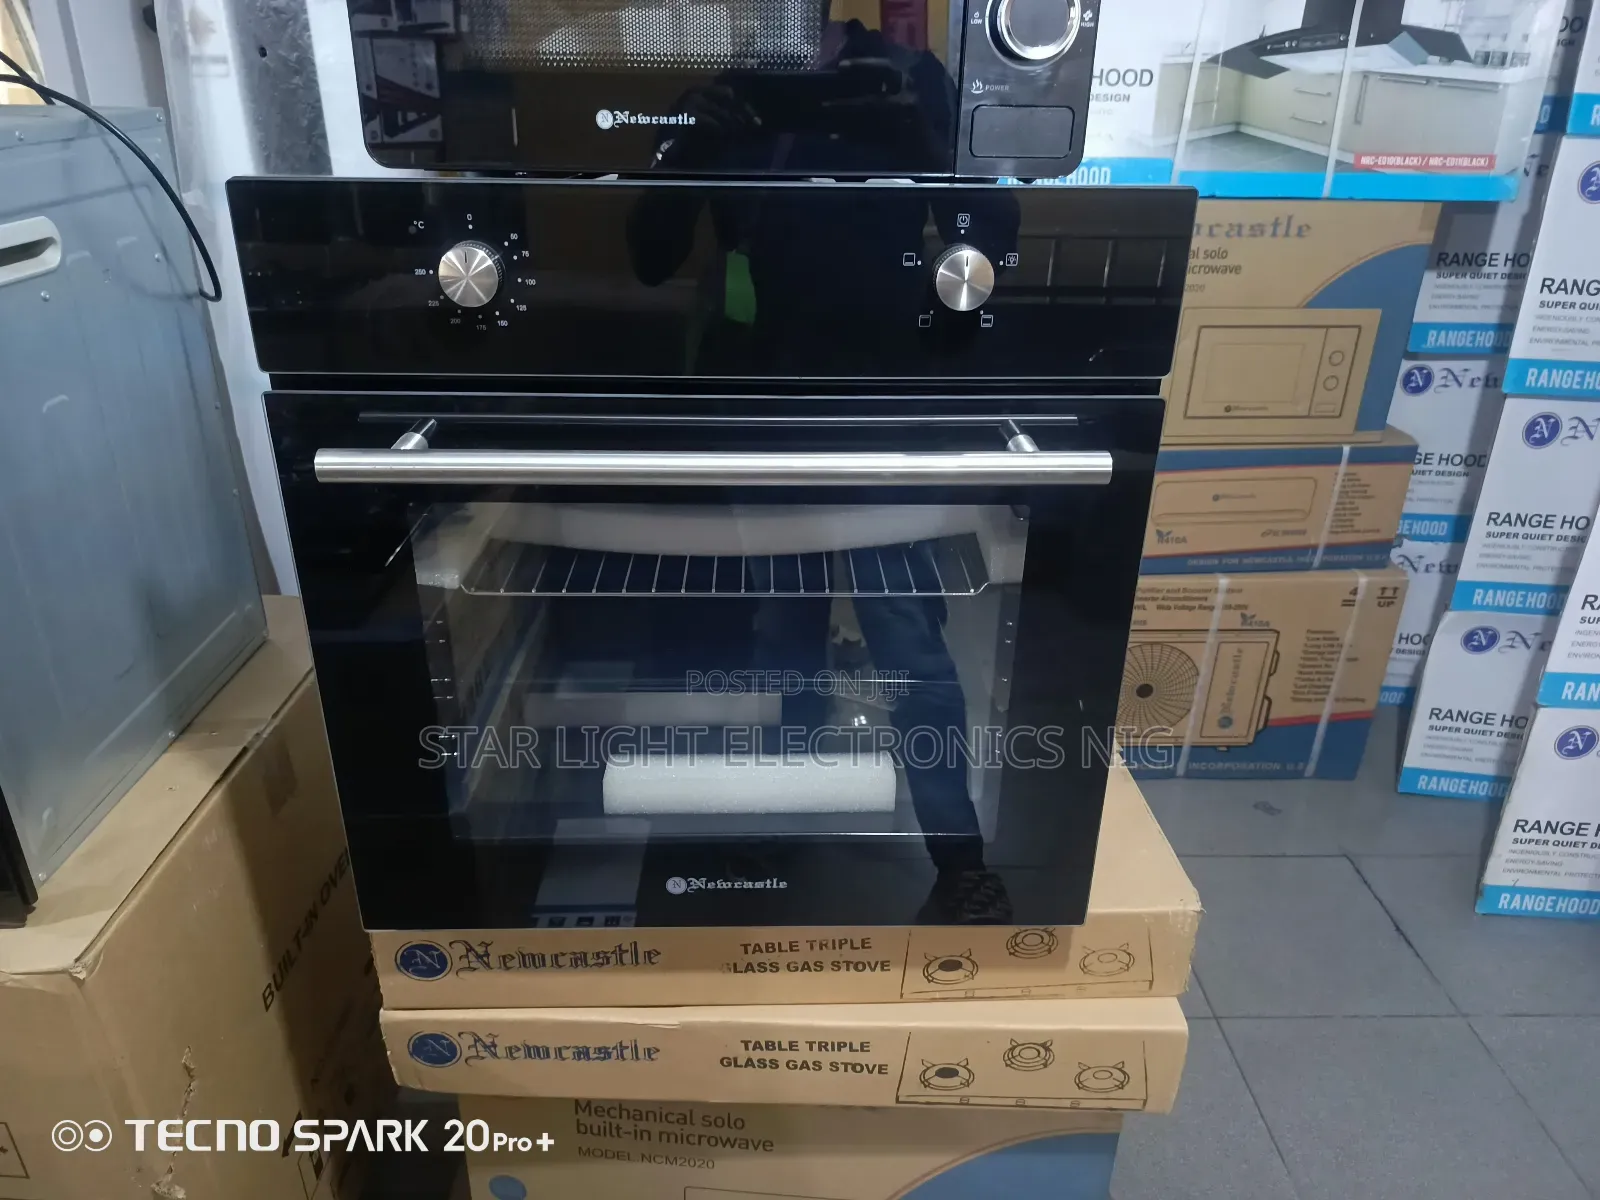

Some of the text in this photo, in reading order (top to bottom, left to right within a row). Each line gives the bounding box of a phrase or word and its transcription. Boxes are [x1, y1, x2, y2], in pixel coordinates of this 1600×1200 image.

[613, 110, 696, 128] Newcastle
[1203, 247, 1228, 260] solo
[1436, 252, 1500, 268] RANGE
[1436, 272, 1468, 280] SUPER
[1469, 272, 1498, 280] QUIET
[1539, 300, 1576, 309] SUPER
[1486, 512, 1591, 531] RANGE HO
[1485, 531, 1520, 540] SUPER
[1522, 532, 1554, 541] QUIET
[1428, 708, 1497, 726] RANGE
[1428, 724, 1461, 733] SUPER
[1463, 728, 1495, 736] QUIET
[1513, 819, 1591, 837] RANGE
[1512, 838, 1550, 847] SUPER
[1552, 840, 1588, 849] QUIET
[687, 877, 788, 893] Newcastle
[1498, 893, 1600, 915] RANGEHOOD
[740, 937, 872, 955] TABLE TRIPLE
[262, 902, 319, 1012] BUILT-IN
[449, 940, 661, 980] Newcastle
[786, 960, 824, 973] GAS
[830, 960, 891, 973] STOVE
[458, 1031, 660, 1067] Newcastle
[740, 1040, 871, 1053] TABLE TRIPLE
[719, 1056, 889, 1075] GLASS GAS STOVE
[574, 1099, 746, 1130] Mechanical solo
[576, 1119, 775, 1152] built-in microwave
